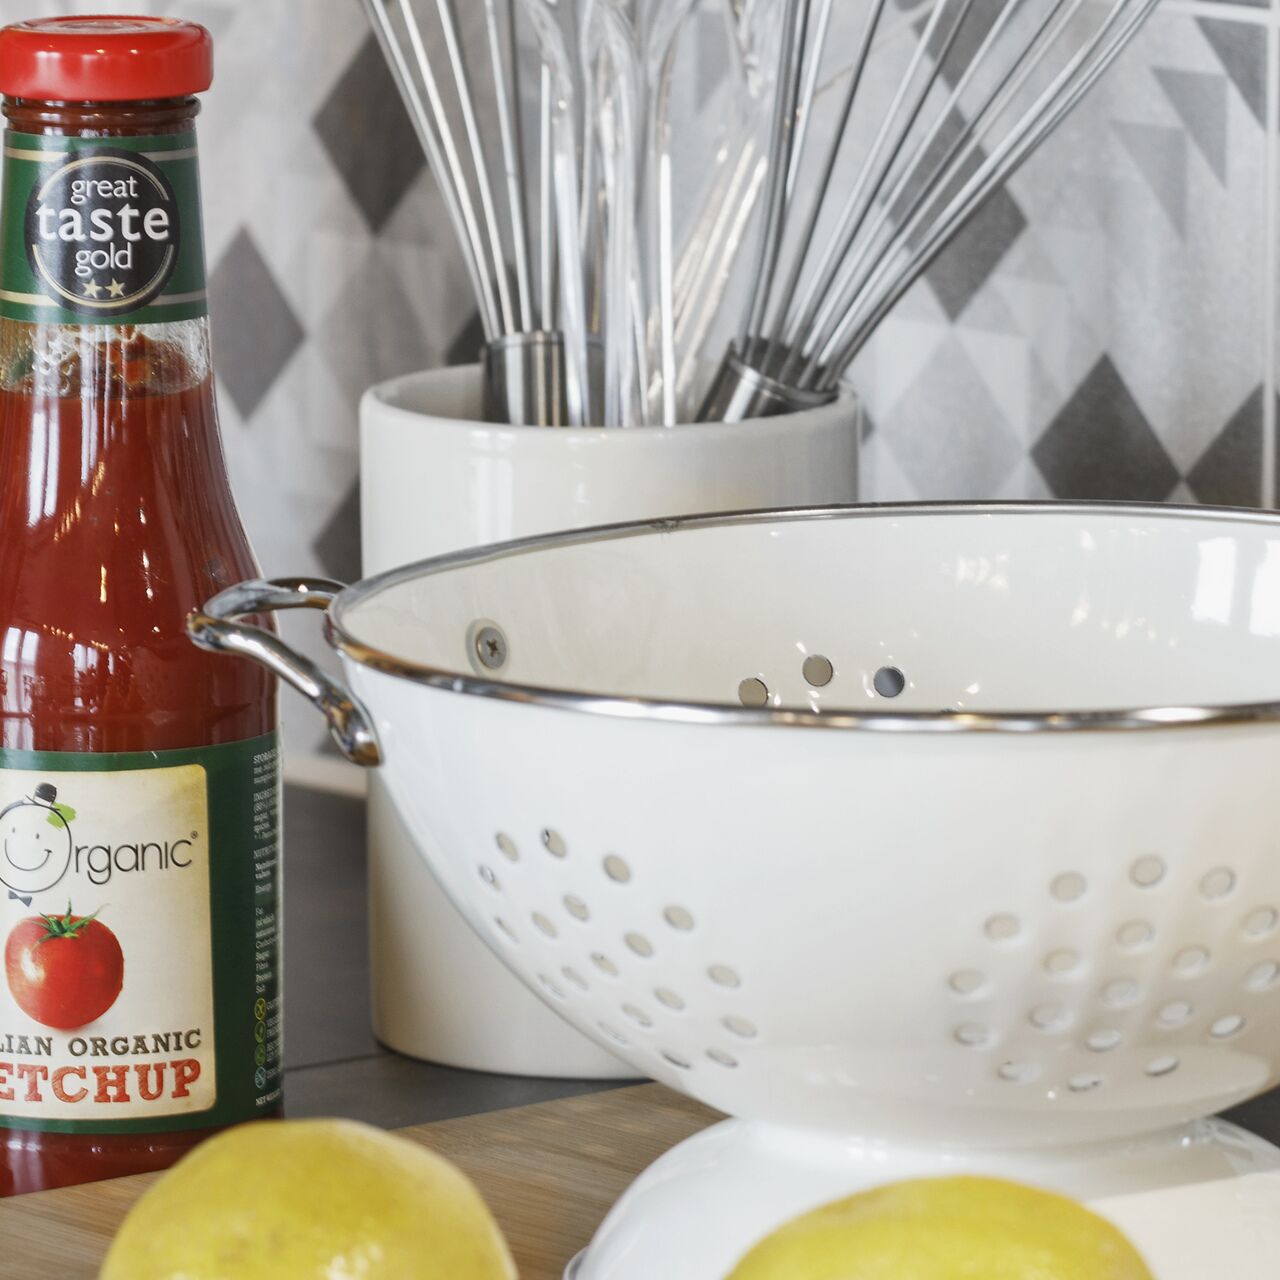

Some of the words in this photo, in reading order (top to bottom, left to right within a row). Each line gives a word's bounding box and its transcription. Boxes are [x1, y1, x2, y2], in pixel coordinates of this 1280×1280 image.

[71, 176, 137, 205] great
[36, 202, 169, 241] taste
[75, 242, 132, 276] gold
[67, 1028, 202, 1057] ORGANIC
